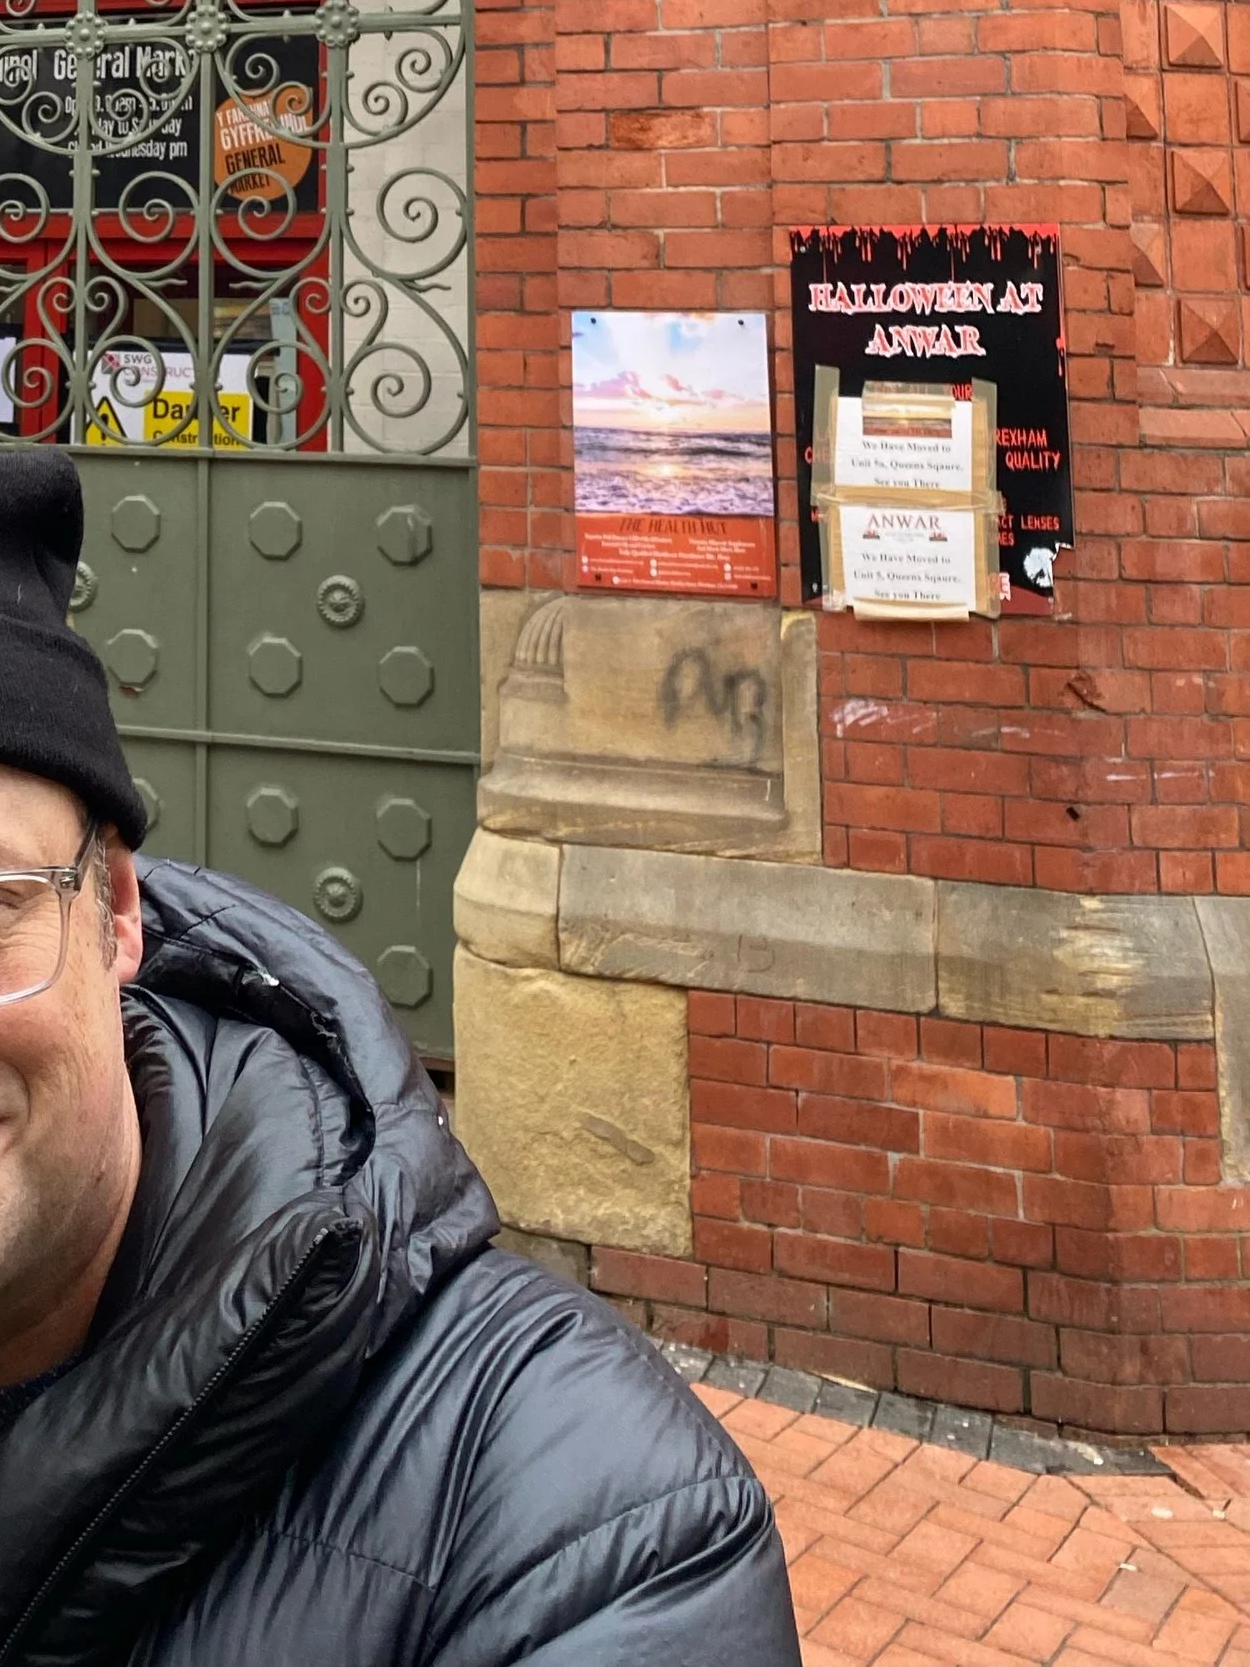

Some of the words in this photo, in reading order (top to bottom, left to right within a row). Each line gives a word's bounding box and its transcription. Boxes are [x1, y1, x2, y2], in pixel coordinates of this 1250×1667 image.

[225, 142, 286, 175] GENERAL
[808, 281, 994, 315] HALLOWEEN
[996, 280, 1043, 314] AT
[864, 323, 986, 358] ANWAR
[124, 353, 152, 364] SWG
[862, 440, 877, 450] We
[881, 441, 903, 451] Have
[907, 442, 938, 452] Moved
[1005, 450, 1061, 472] QUALITY
[914, 479, 940, 488] There
[620, 517, 643, 533] THE
[649, 518, 696, 535] HEALTH
[698, 520, 727, 535] HUT
[868, 514, 940, 529] ANWAR
[1021, 514, 1060, 531] LENSES
[862, 552, 877, 562] We
[880, 553, 904, 563] Have
[907, 554, 938, 564] Moved
[914, 591, 941, 600] There
